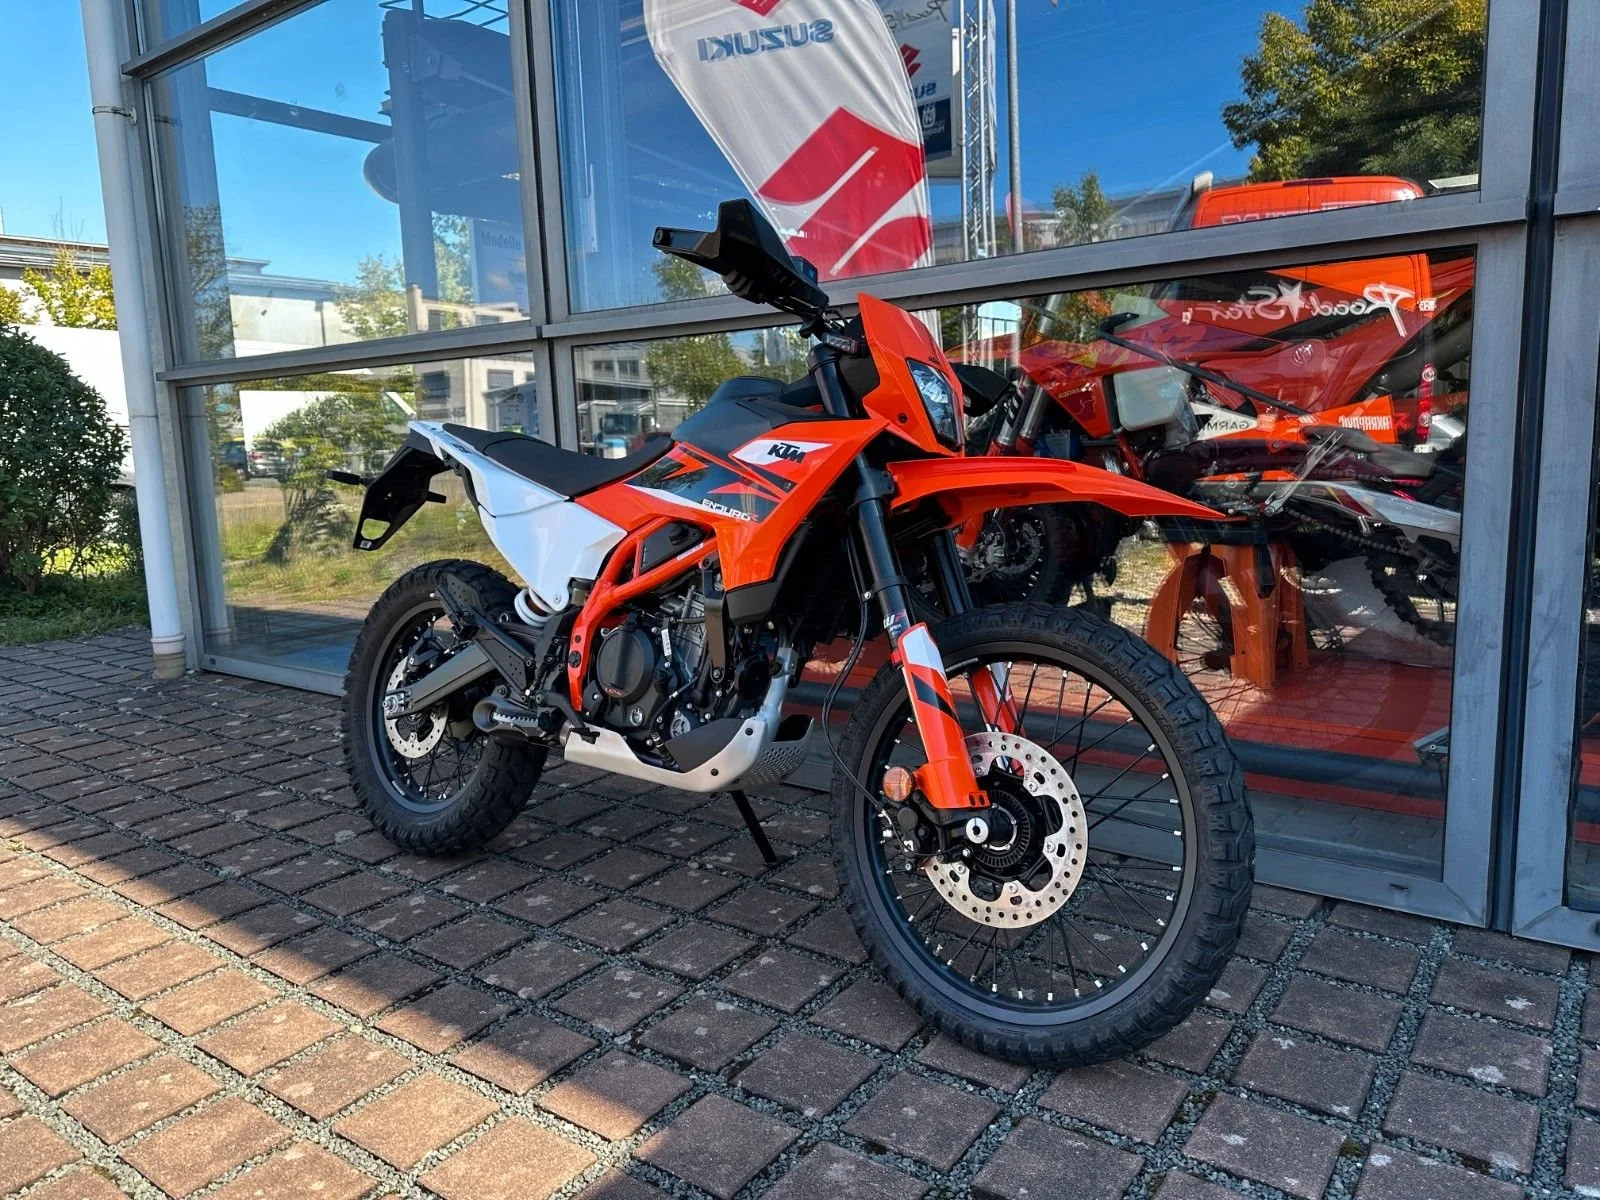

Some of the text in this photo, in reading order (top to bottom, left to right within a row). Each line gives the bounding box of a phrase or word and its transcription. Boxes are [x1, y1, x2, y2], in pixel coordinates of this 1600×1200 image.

[481, 230, 522, 251] Modelle
[767, 442, 807, 464] KTM
[702, 498, 751, 521] ENDURO
[1102, 661, 1159, 713] ENDURO
